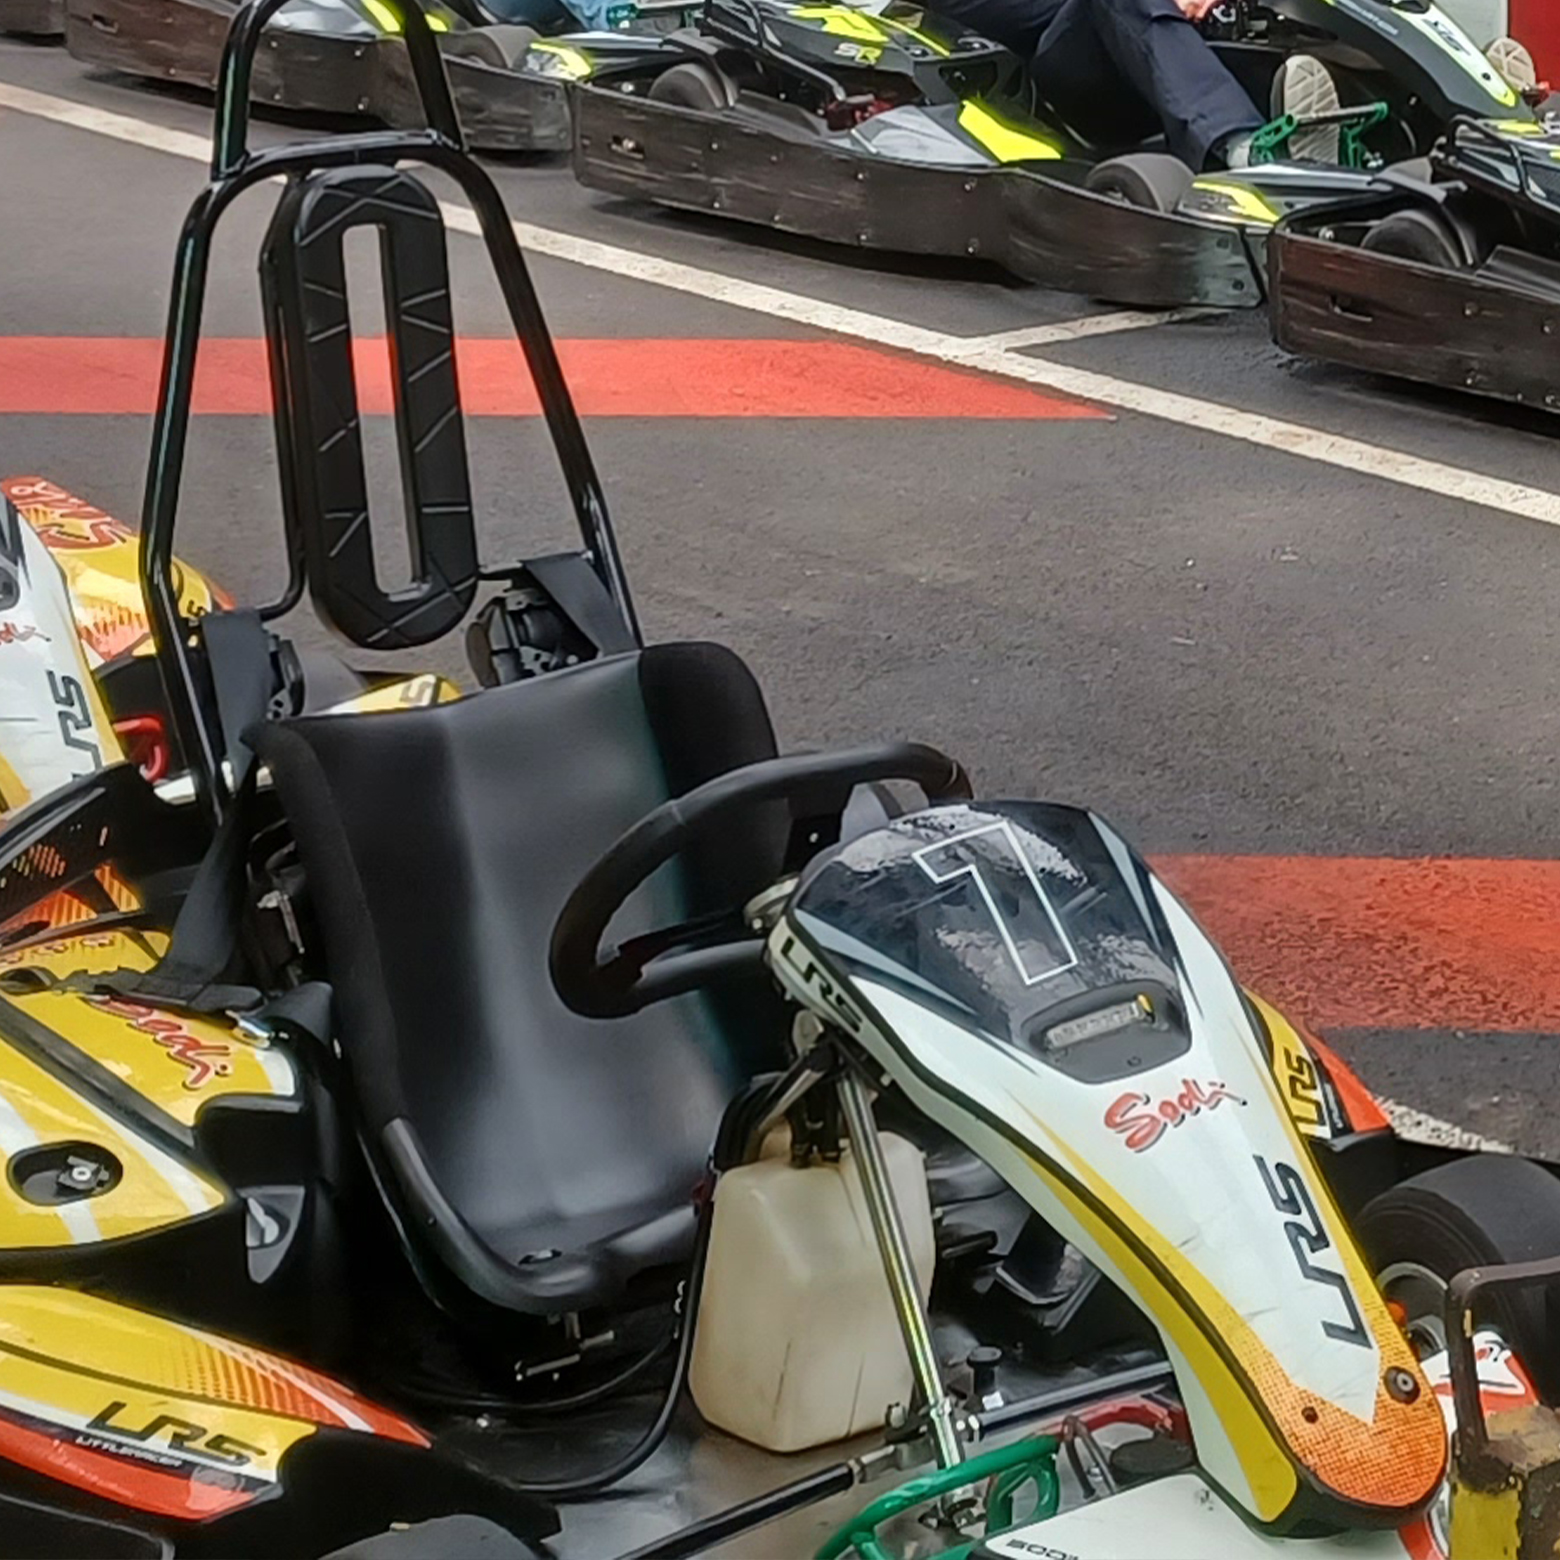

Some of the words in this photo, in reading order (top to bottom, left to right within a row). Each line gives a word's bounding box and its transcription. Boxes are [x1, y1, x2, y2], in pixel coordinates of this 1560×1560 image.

[781, 936, 863, 1033] LRS
[1103, 1077, 1248, 1154] Sodi
[1283, 1045, 1327, 1127] LRS
[1253, 1153, 1375, 1351] LRS
[86, 1400, 268, 1467] LRS
